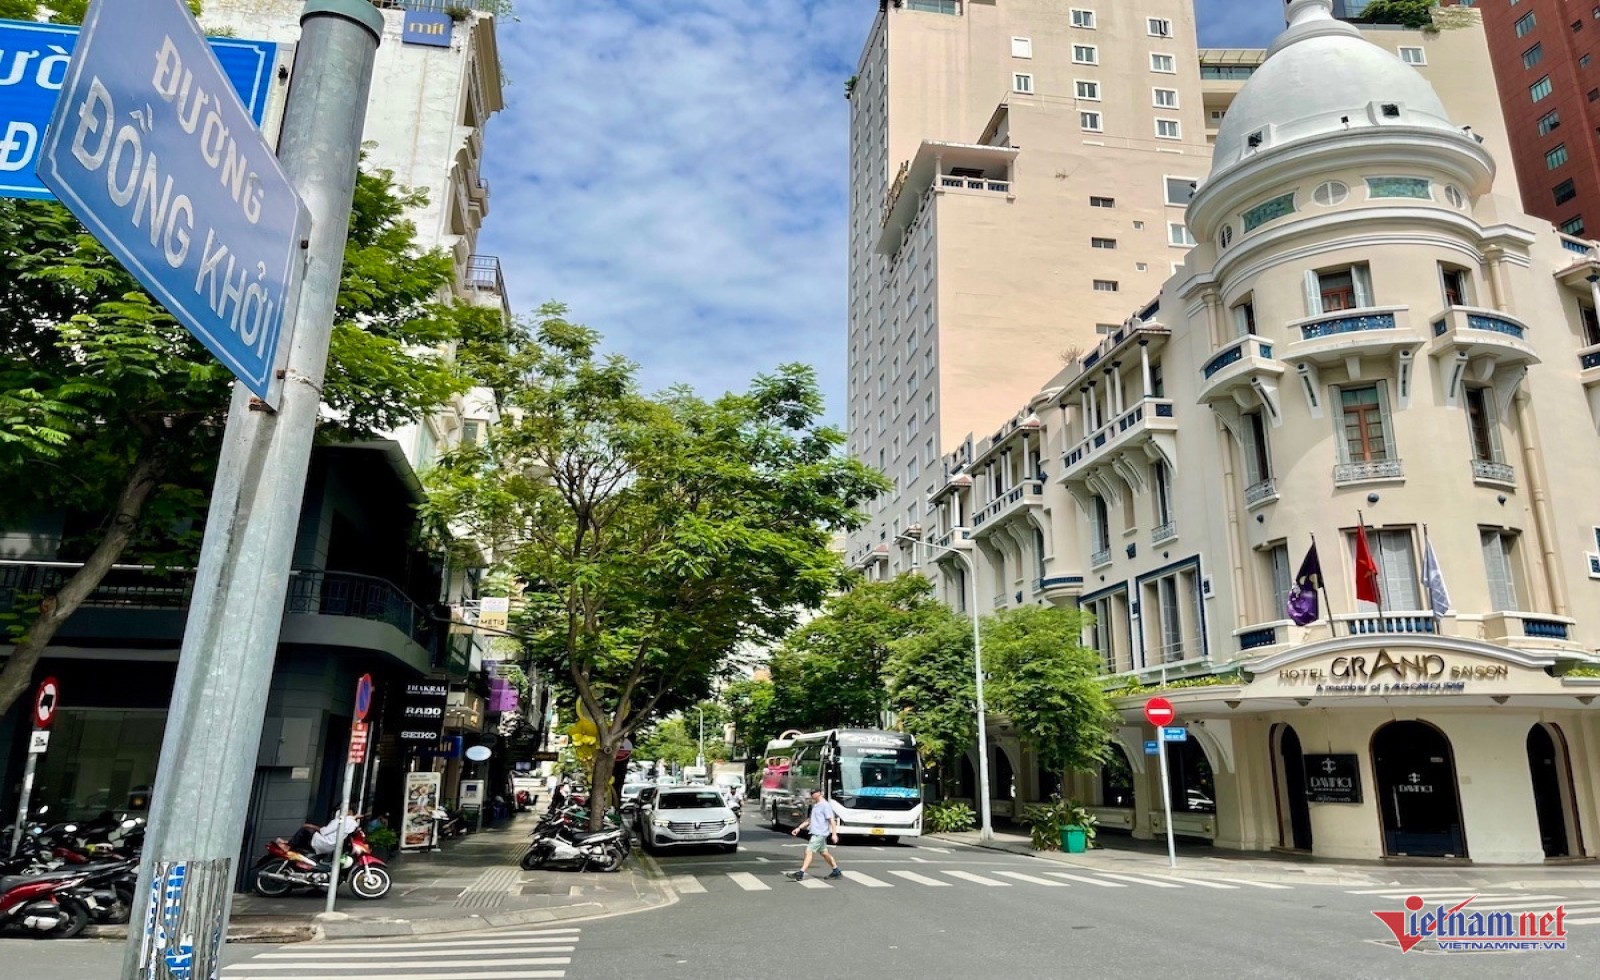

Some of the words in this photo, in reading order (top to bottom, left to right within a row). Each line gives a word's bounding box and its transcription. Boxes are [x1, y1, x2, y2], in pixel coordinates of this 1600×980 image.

[152, 34, 264, 224] ĐƯỜNG
[71, 75, 194, 269] ĐỒNG
[195, 227, 273, 360] KHỞI
[1279, 669, 1326, 679] HOTEL
[1331, 648, 1445, 679] GRAND
[405, 707, 442, 715] RADO
[401, 731, 437, 739] SEIKO
